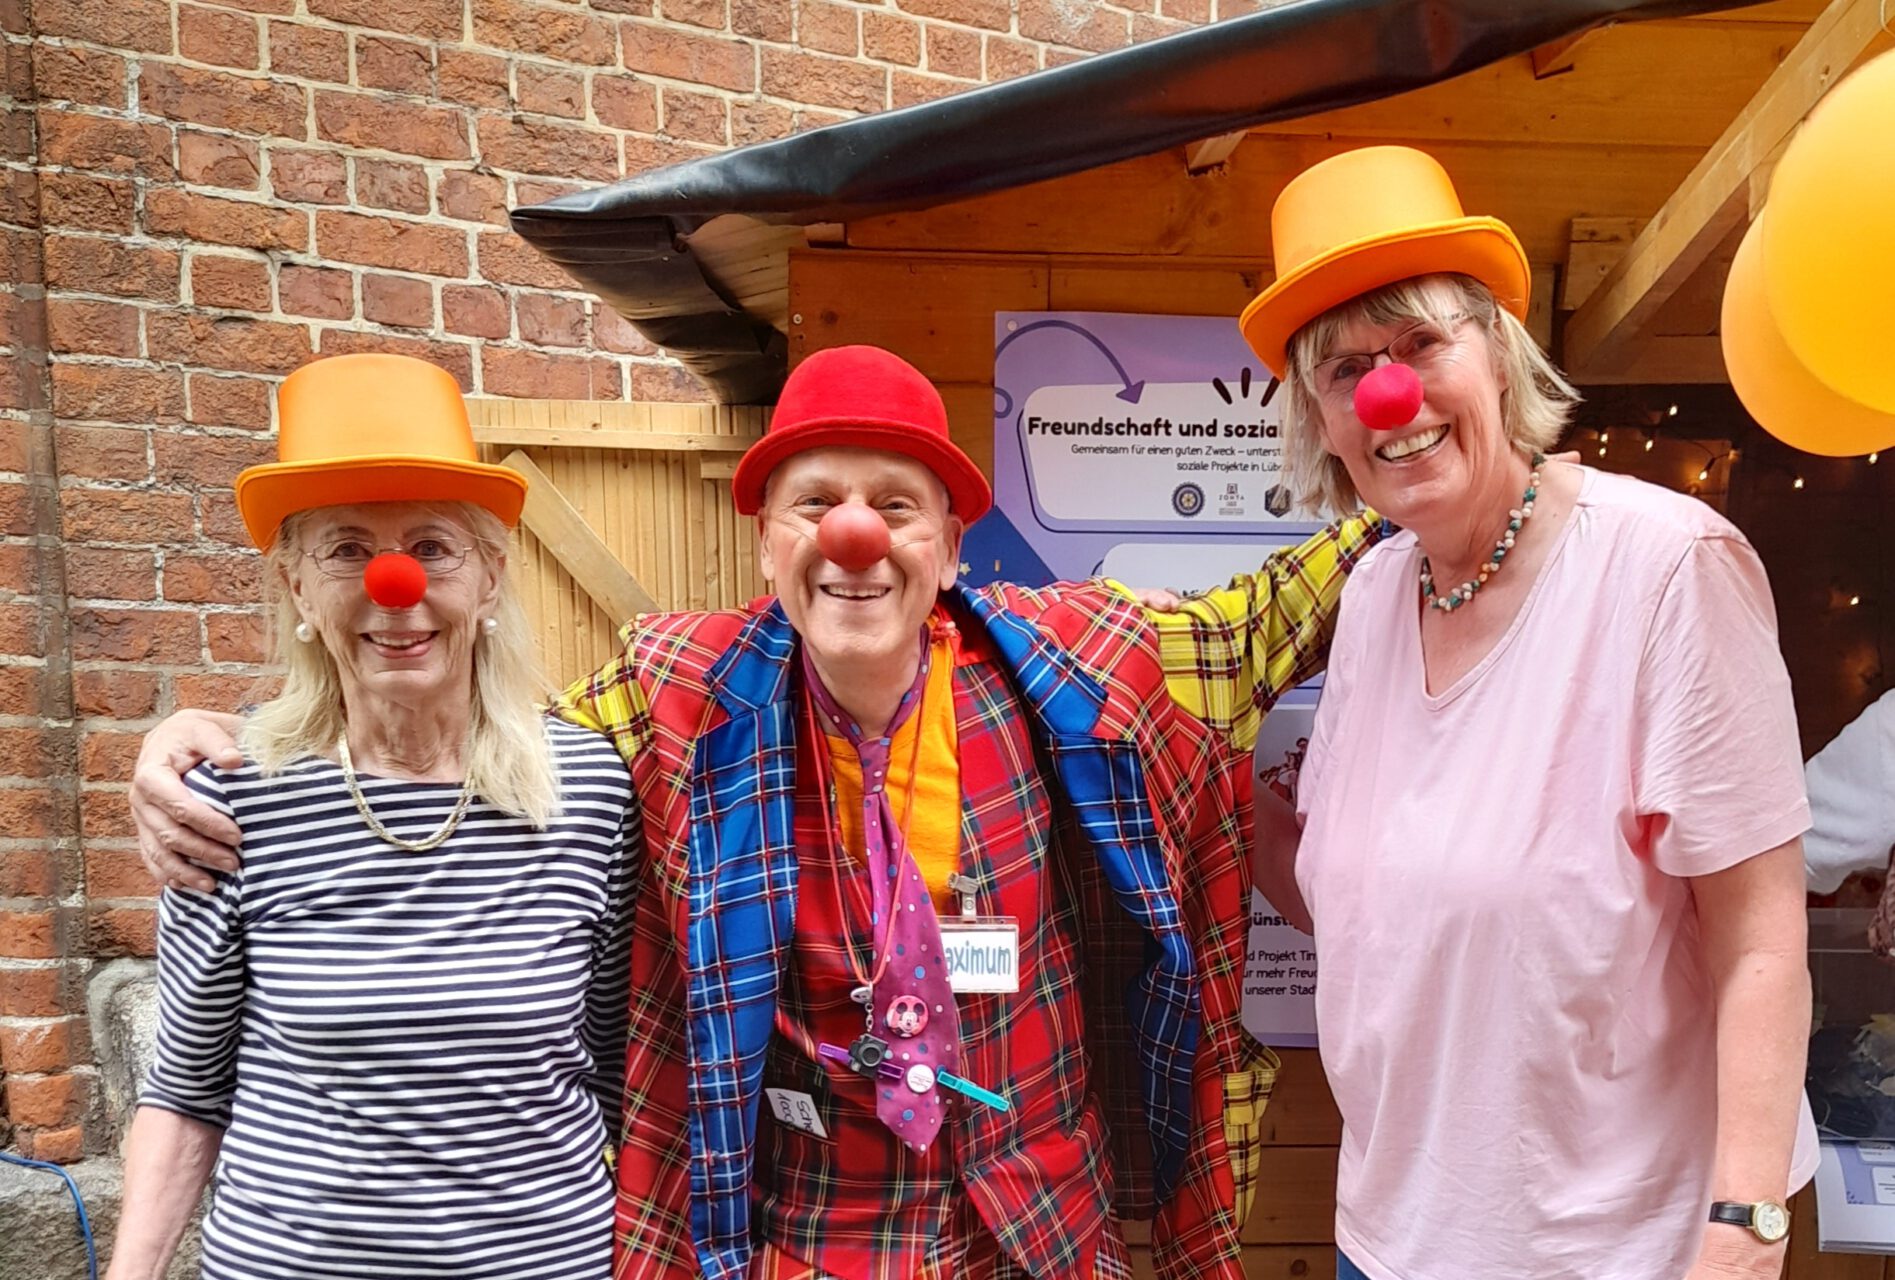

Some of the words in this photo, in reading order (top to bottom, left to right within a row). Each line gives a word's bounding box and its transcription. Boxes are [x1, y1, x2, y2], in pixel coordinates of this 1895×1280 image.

[1028, 416, 1172, 437] Freundschaft
[1178, 418, 1217, 437] und
[1071, 444, 1129, 455] Gemeinsam
[1131, 444, 1145, 455] für
[1147, 445, 1173, 455] einen
[1175, 446, 1202, 458] guten
[1205, 446, 1235, 456] Zweck
[1176, 461, 1209, 471] soziale
[1211, 461, 1249, 474] Projekte
[1251, 461, 1260, 472] in
[944, 939, 1011, 976] aximum
[1258, 950, 1297, 964] Projekt
[1256, 967, 1285, 978] mehr
[1245, 986, 1287, 996] unserer
